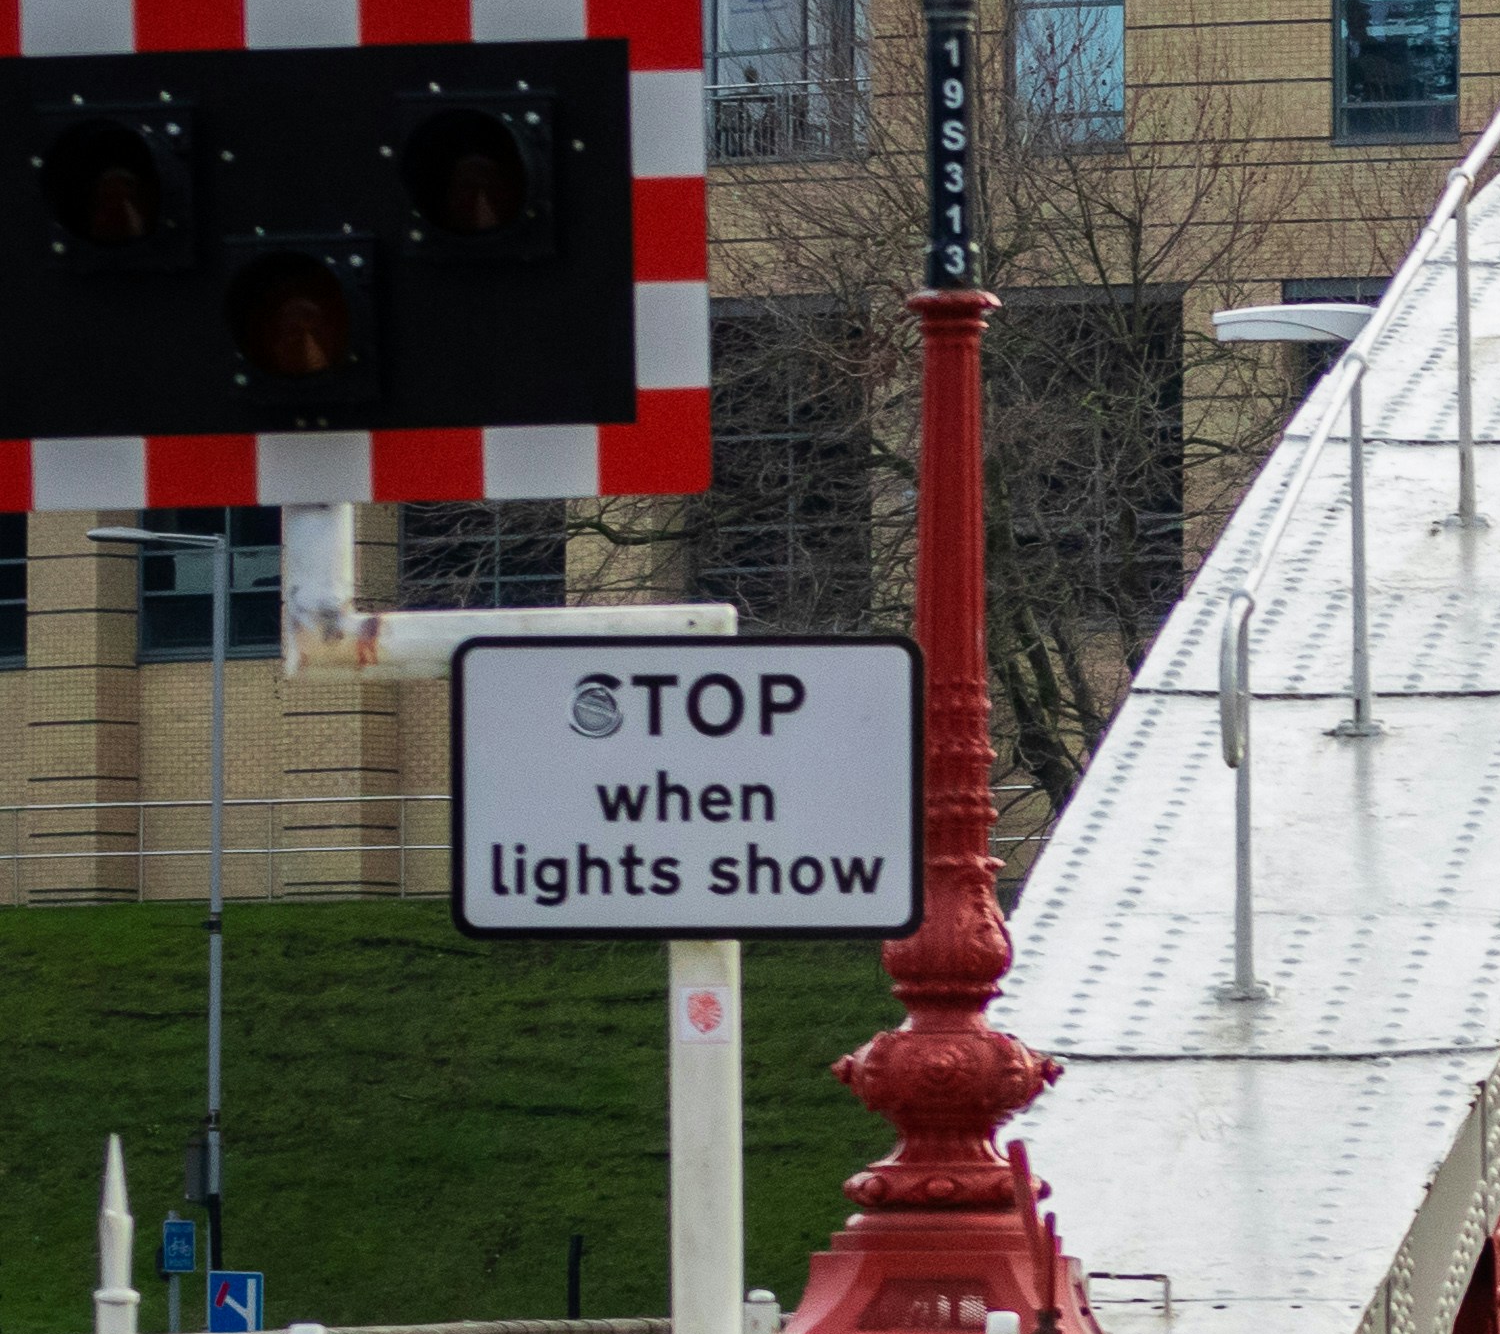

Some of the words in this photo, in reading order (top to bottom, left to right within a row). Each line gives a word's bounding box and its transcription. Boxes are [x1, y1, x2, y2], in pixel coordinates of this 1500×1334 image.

[596, 770, 775, 823] when
[491, 843, 682, 907] lights
[708, 842, 884, 896] show
